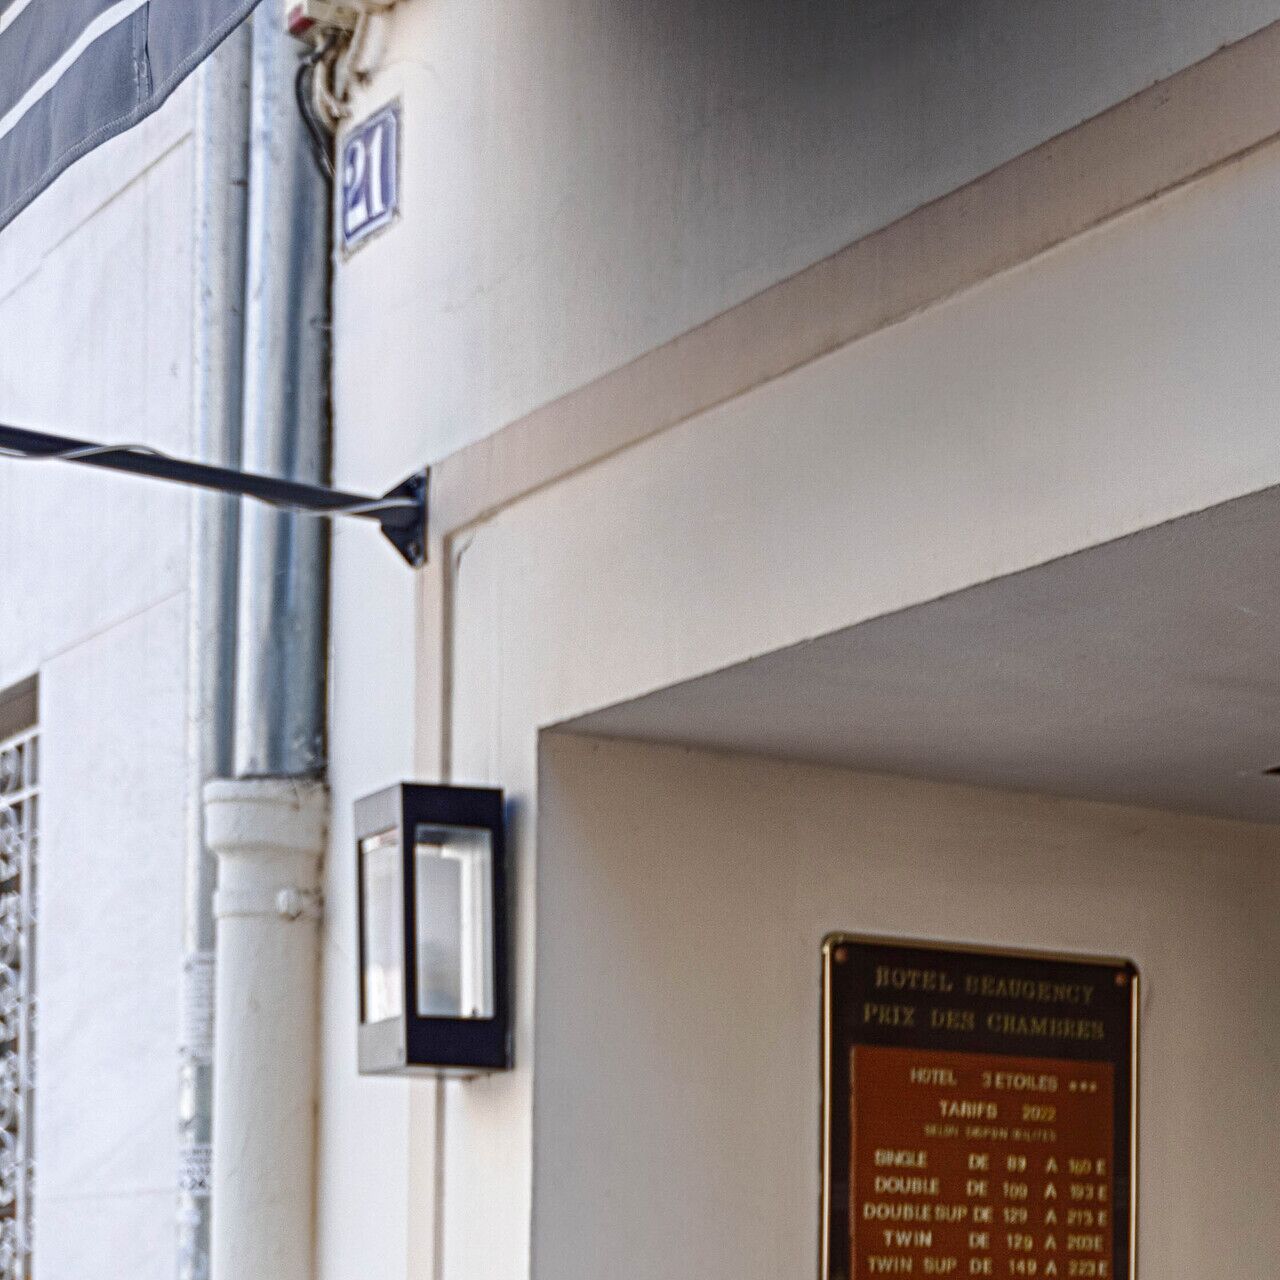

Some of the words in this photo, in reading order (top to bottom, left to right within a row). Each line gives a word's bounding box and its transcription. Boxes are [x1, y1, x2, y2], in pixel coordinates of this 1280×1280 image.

[345, 125, 385, 229] 21
[875, 964, 953, 993] HOTEL
[863, 1002, 915, 1027] PRIX
[931, 1007, 976, 1031] DES
[910, 1067, 957, 1086] HOTEL
[940, 1100, 998, 1120] TARIFS
[874, 1149, 928, 1168] SINGLE
[968, 1153, 989, 1171] DE
[1046, 1156, 1059, 1175] A
[875, 1176, 940, 1196] DOUBLE
[966, 1179, 988, 1198] DE
[1044, 1181, 1058, 1201] A
[863, 1202, 931, 1222] DOUBLE
[934, 1203, 968, 1222] SUP
[973, 1205, 993, 1223] DE
[1045, 1207, 1058, 1226] A
[883, 1228, 932, 1248] TWIN
[968, 1232, 990, 1250] DE
[1044, 1233, 1058, 1251] A
[867, 1255, 913, 1274] TWIN
[923, 1255, 958, 1275] SUP
[969, 1257, 992, 1276] DE
[1045, 1258, 1058, 1277] A
